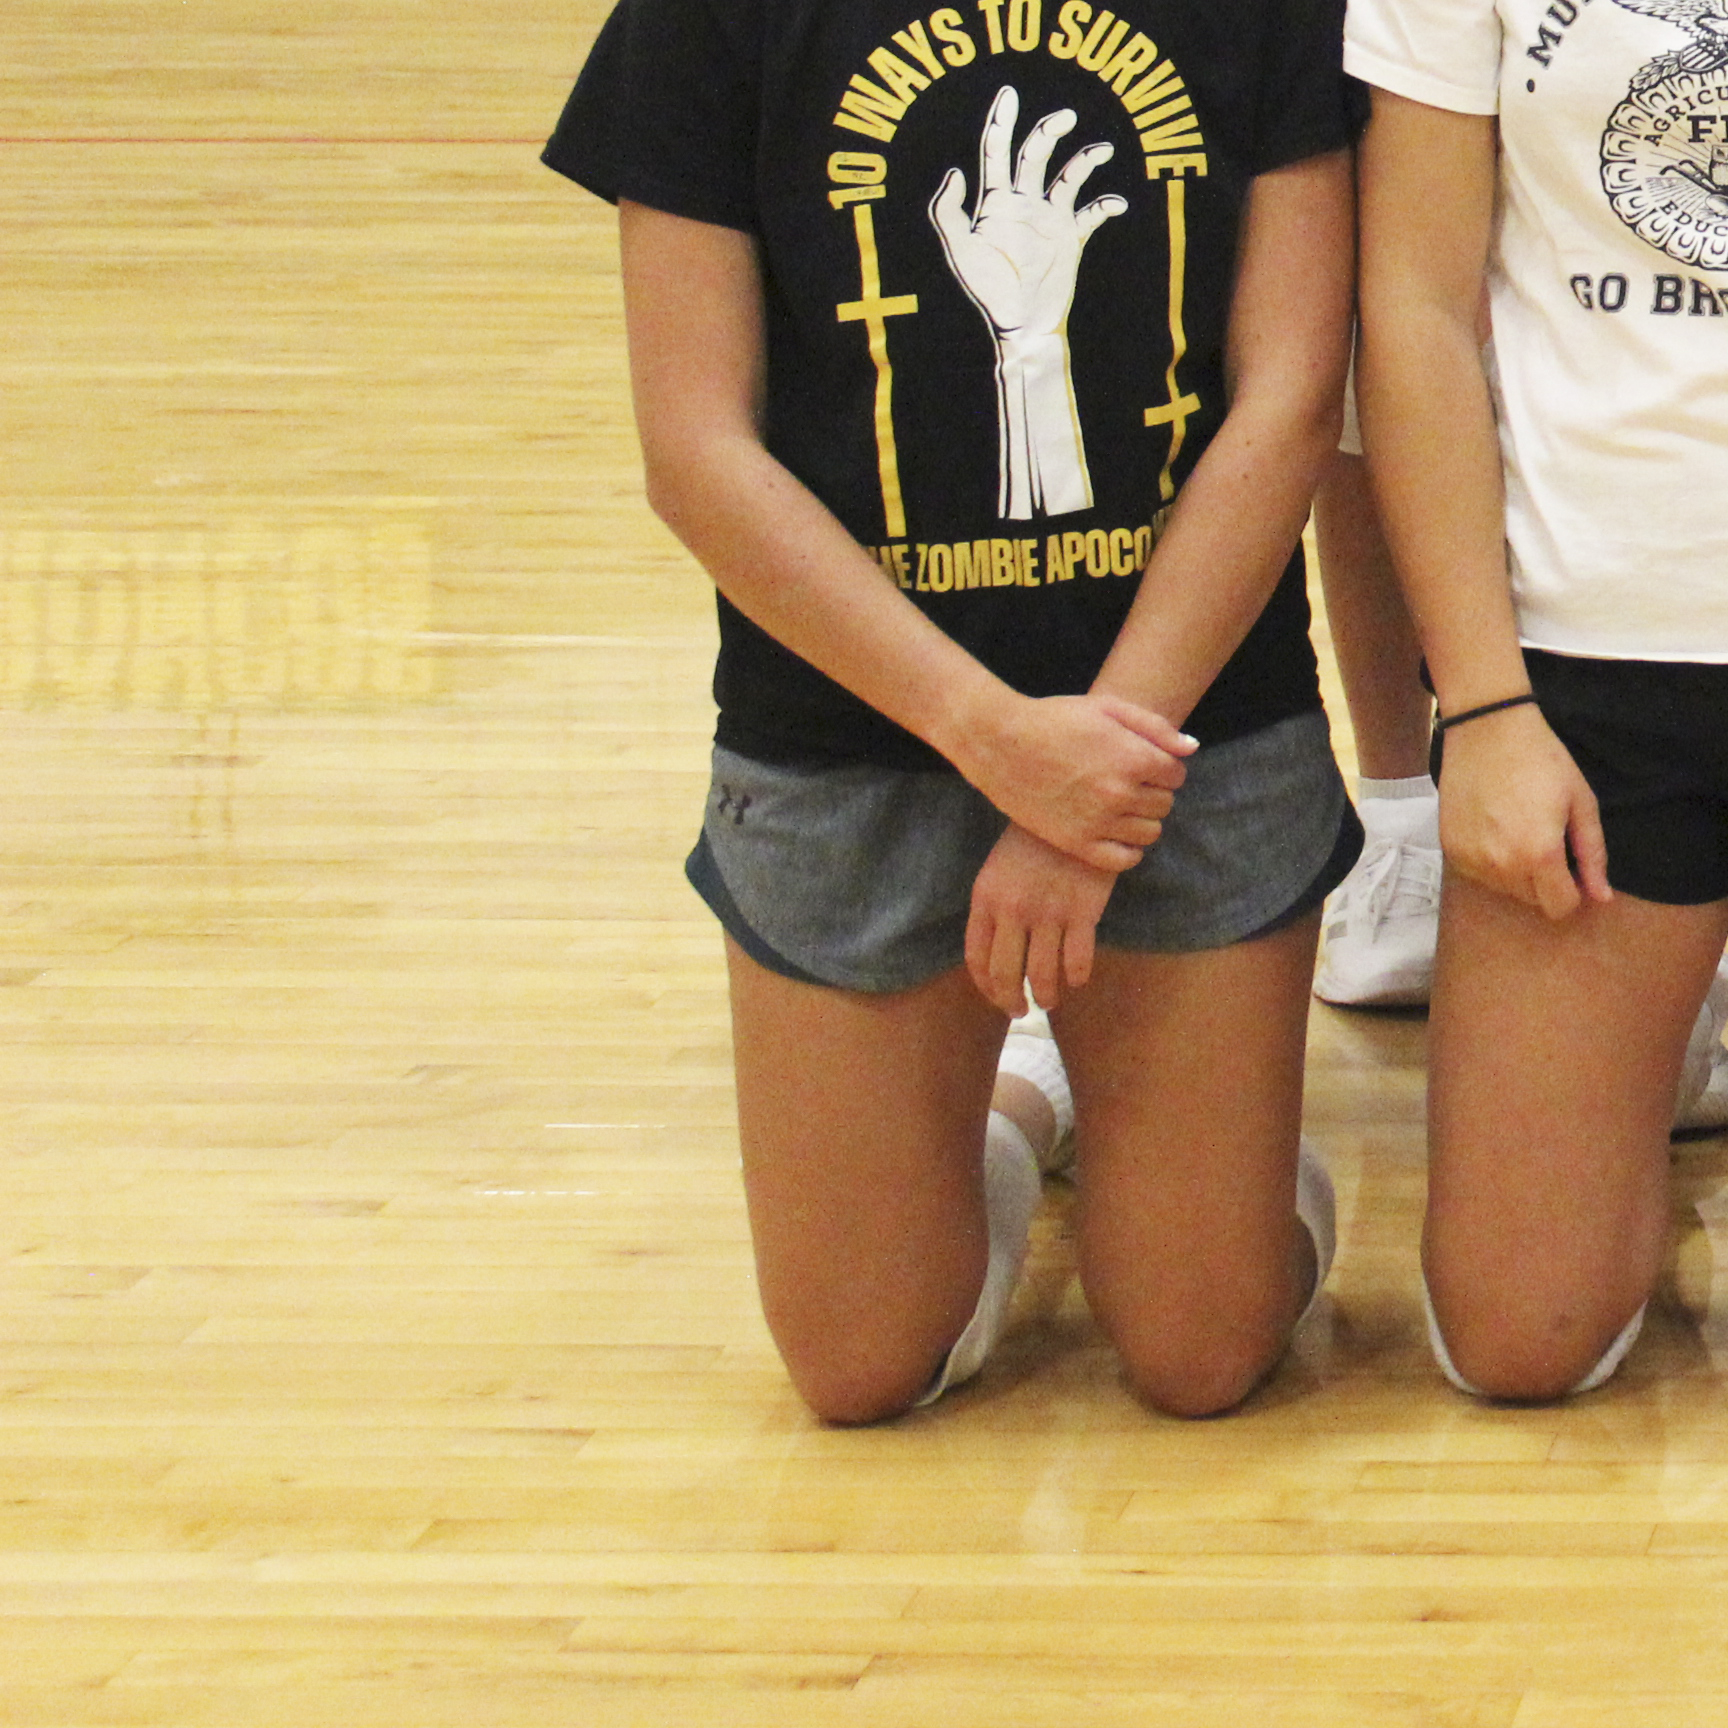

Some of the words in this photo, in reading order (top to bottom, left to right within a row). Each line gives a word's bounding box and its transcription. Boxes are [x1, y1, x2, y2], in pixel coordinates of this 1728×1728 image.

[832, 6, 977, 144] WAYS
[826, 150, 888, 211] 10
[1569, 272, 1630, 313] GO
[915, 537, 1041, 593] ZOMBIE
[1045, 508, 1166, 585] APOCO
